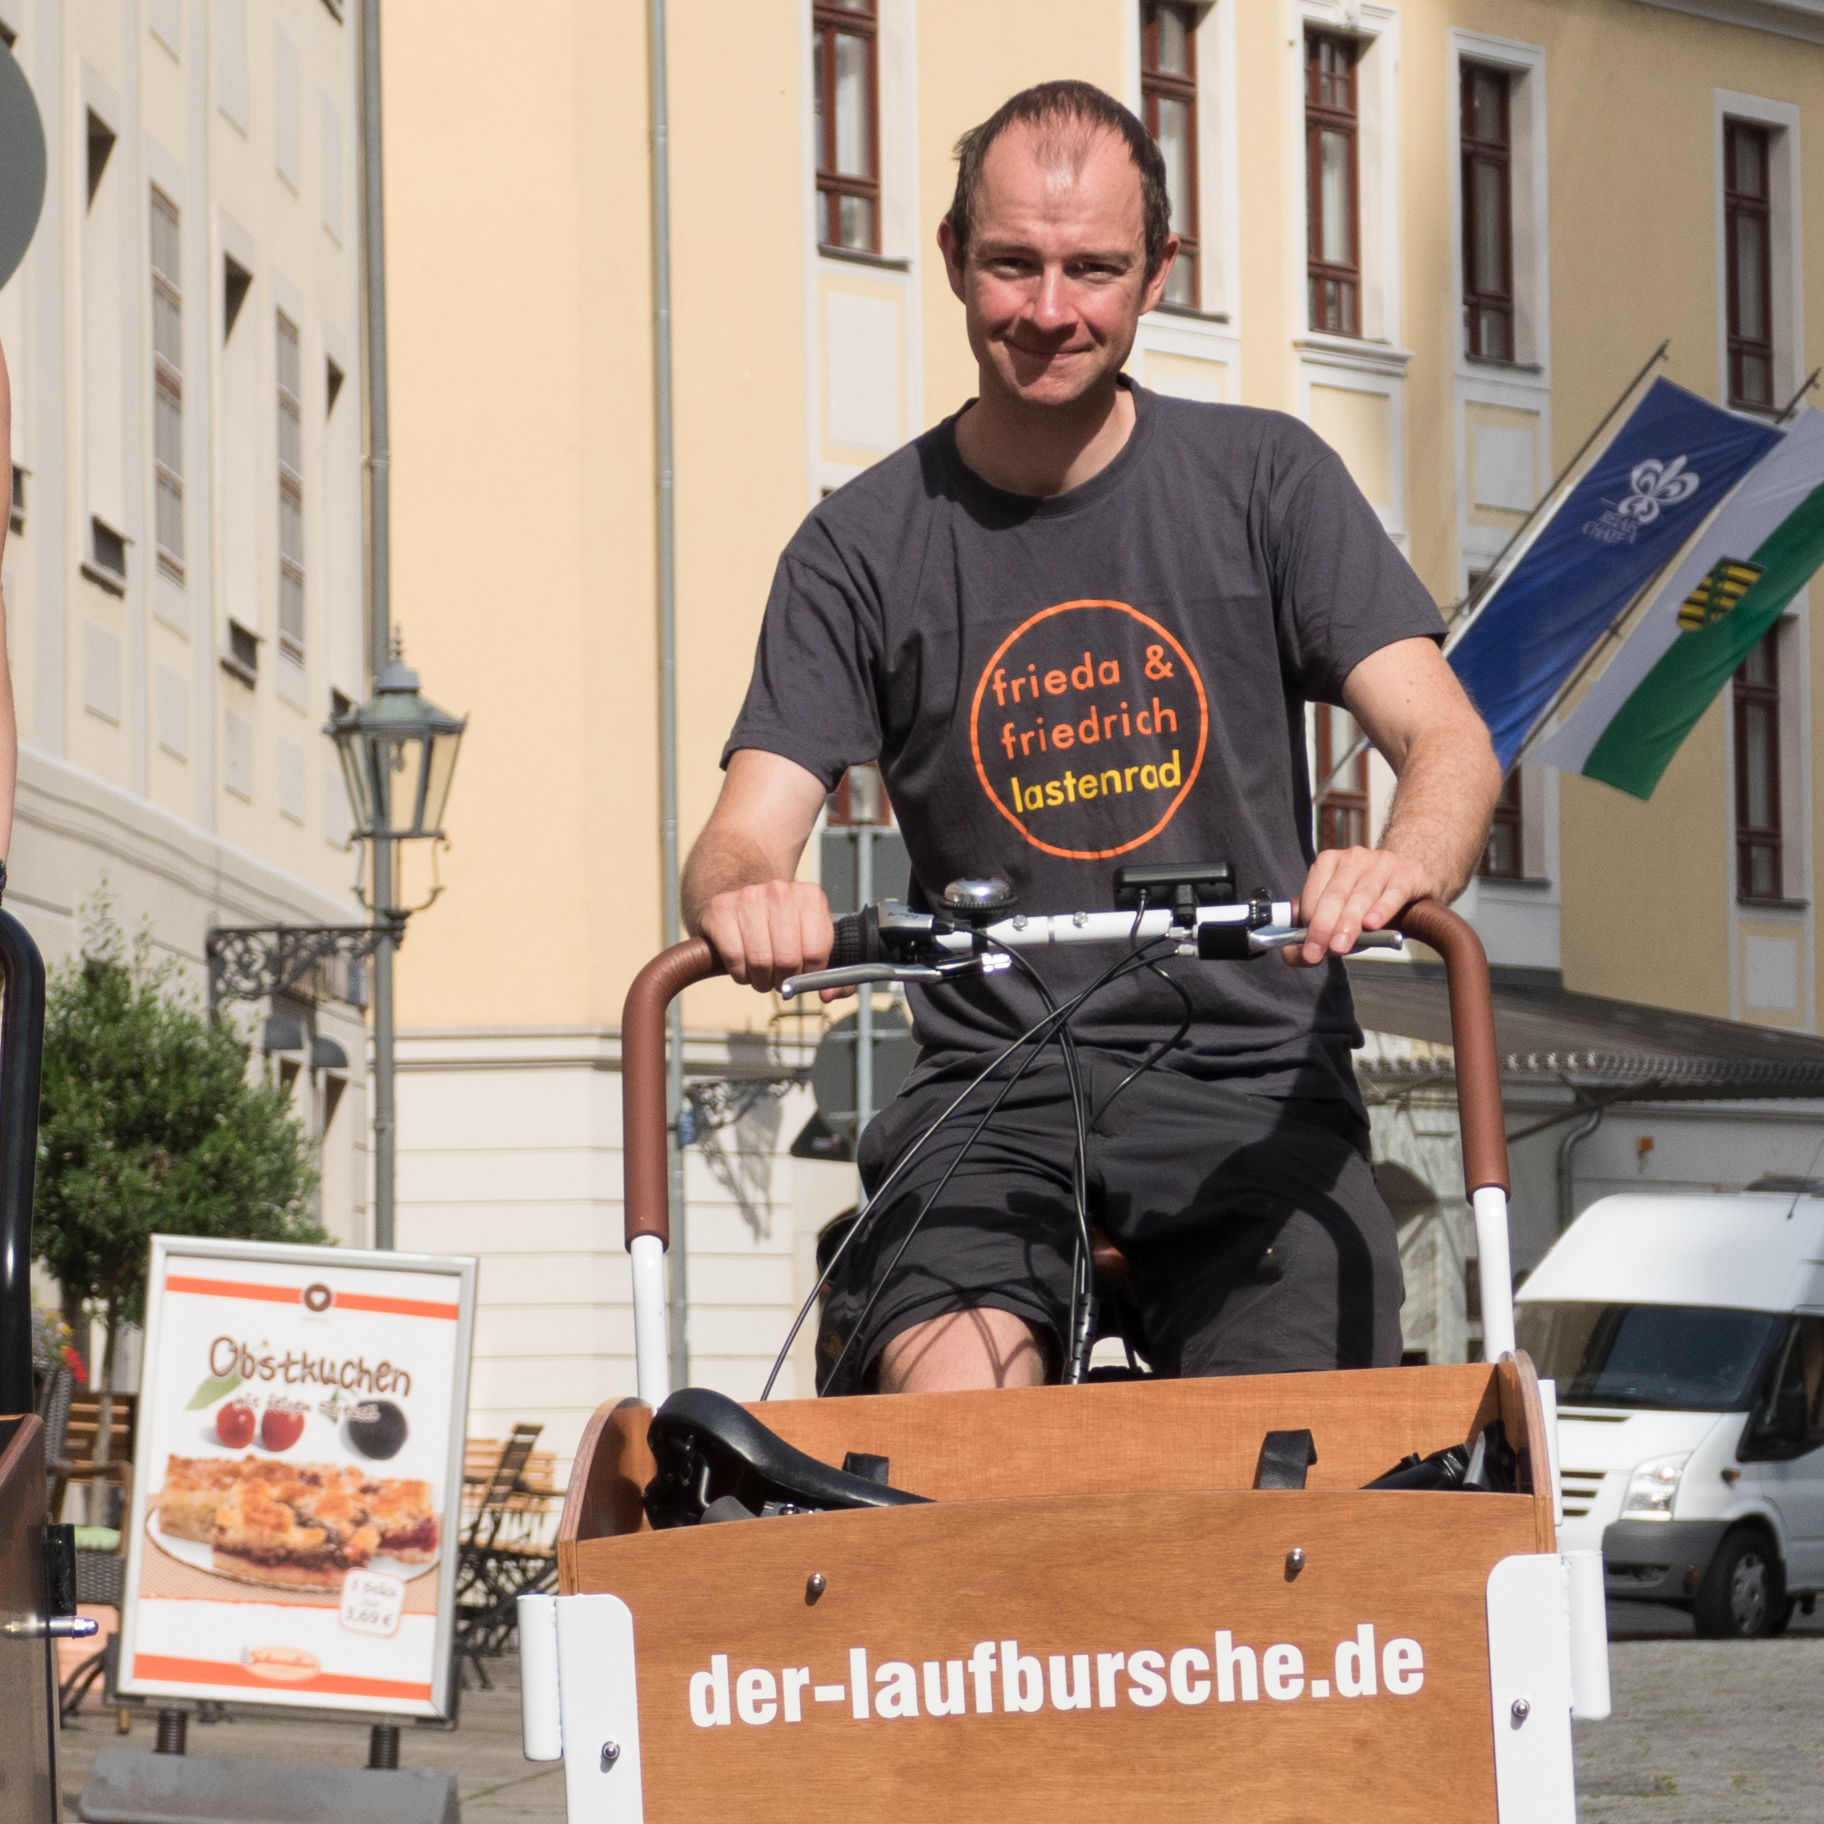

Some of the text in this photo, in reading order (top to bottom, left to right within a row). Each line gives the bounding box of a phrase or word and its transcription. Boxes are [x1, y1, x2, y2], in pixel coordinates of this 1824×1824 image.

[992, 644, 1175, 707] frieda &
[1001, 697, 1178, 760] friedrich
[1010, 749, 1182, 813] lastenrad
[209, 1334, 412, 1397] Obstkuchen
[688, 1622, 1426, 1730] der-laufbursche.de
